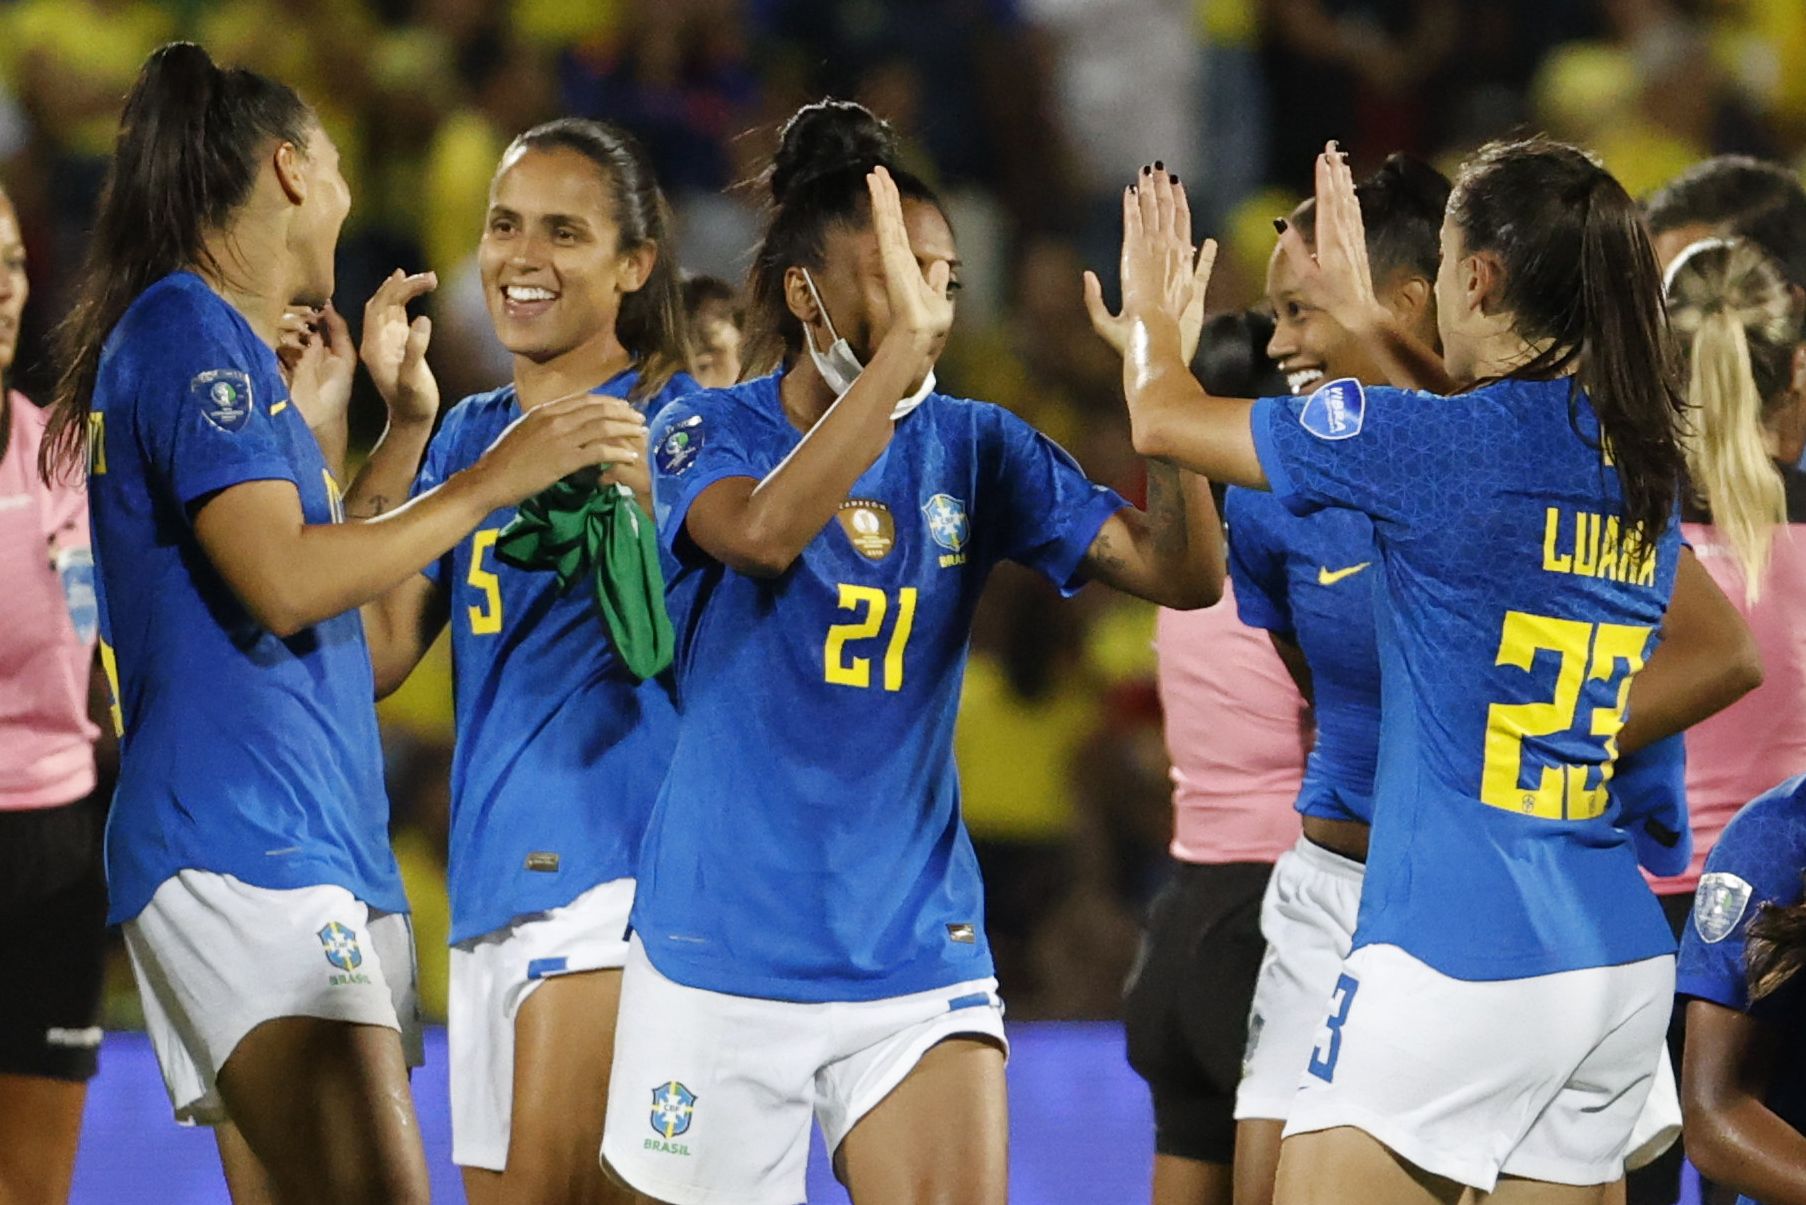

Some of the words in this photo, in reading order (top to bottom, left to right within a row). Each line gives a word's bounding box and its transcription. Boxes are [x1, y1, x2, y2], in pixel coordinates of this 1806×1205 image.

[1330, 387, 1346, 431] VIBRA
[466, 527, 502, 635] 5
[825, 582, 918, 691] 21
[1481, 610, 1653, 820] 23
[643, 1138, 691, 1156] BRASIL
